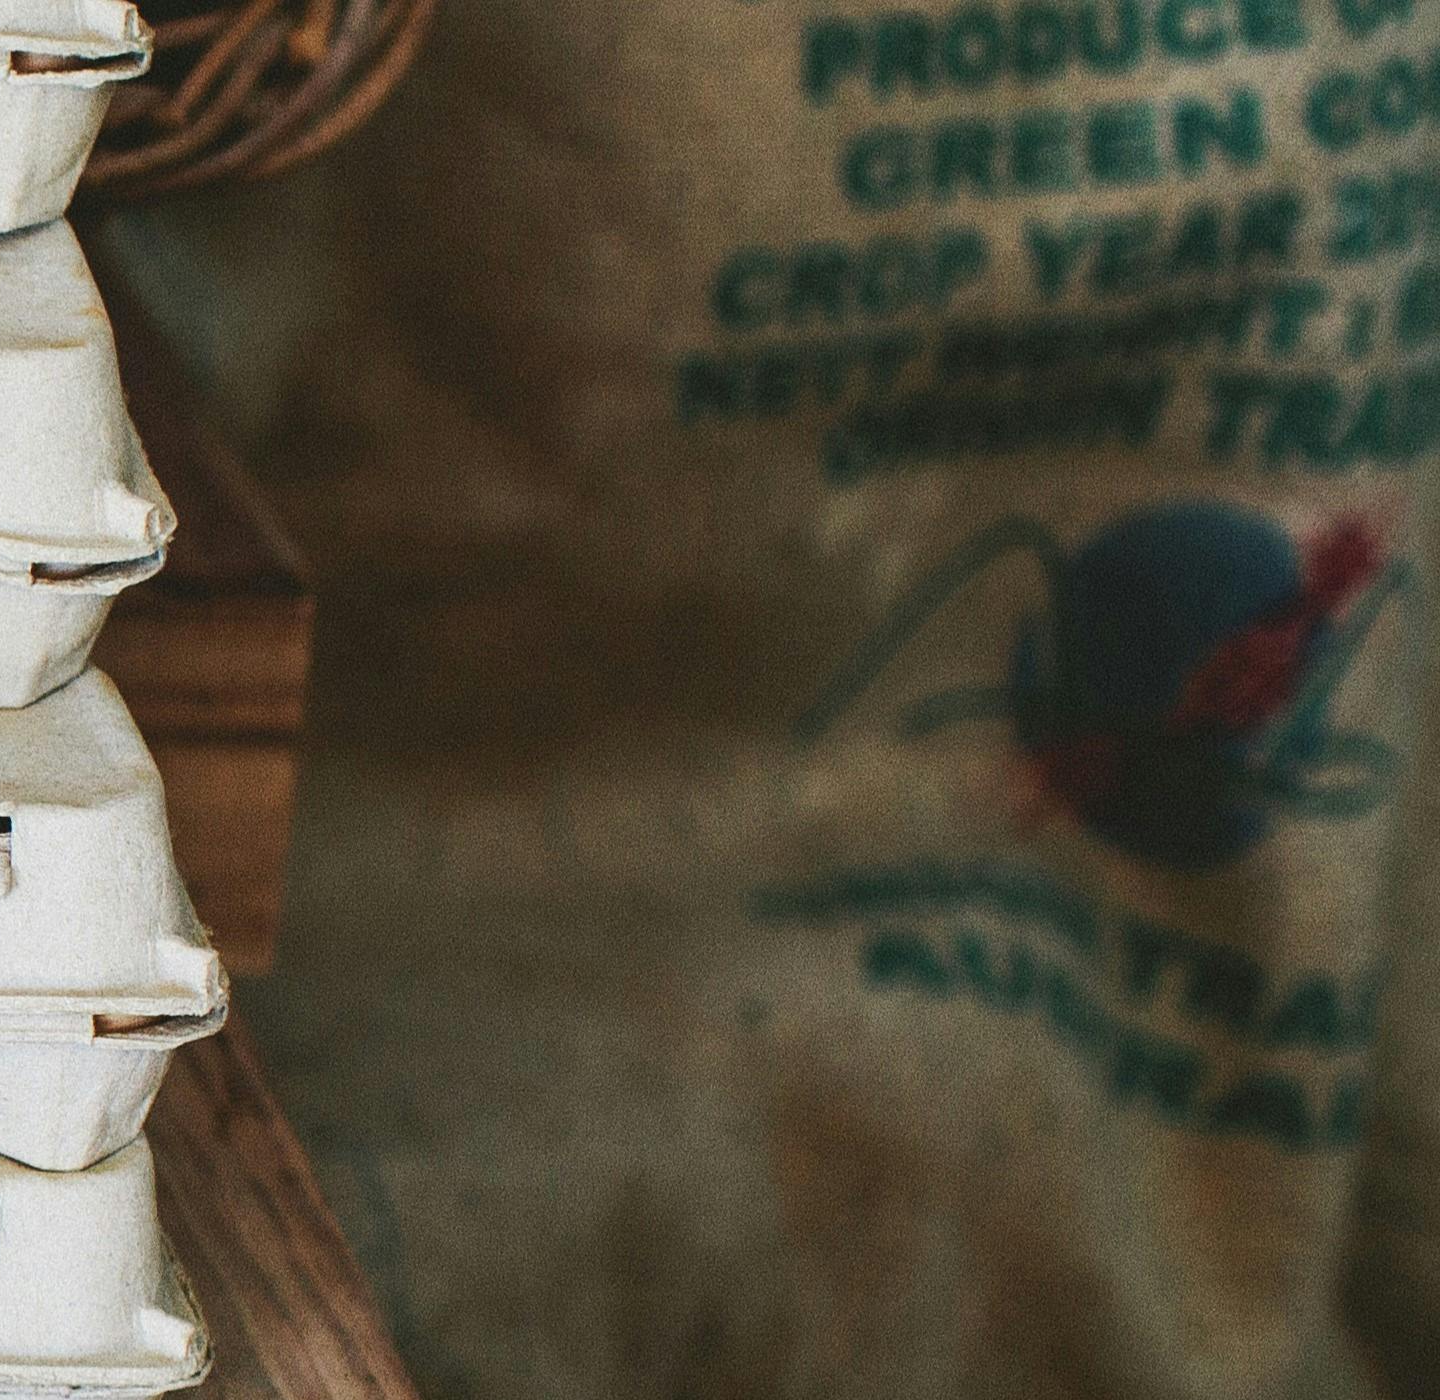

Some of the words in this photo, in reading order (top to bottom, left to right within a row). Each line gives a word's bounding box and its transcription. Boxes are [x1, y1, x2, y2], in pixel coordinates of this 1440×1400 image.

[802, 0, 1308, 106] PRODUCE
[838, 86, 1268, 213] GREEN
[711, 228, 988, 336] CROP
[1023, 187, 1306, 300] YEAR
